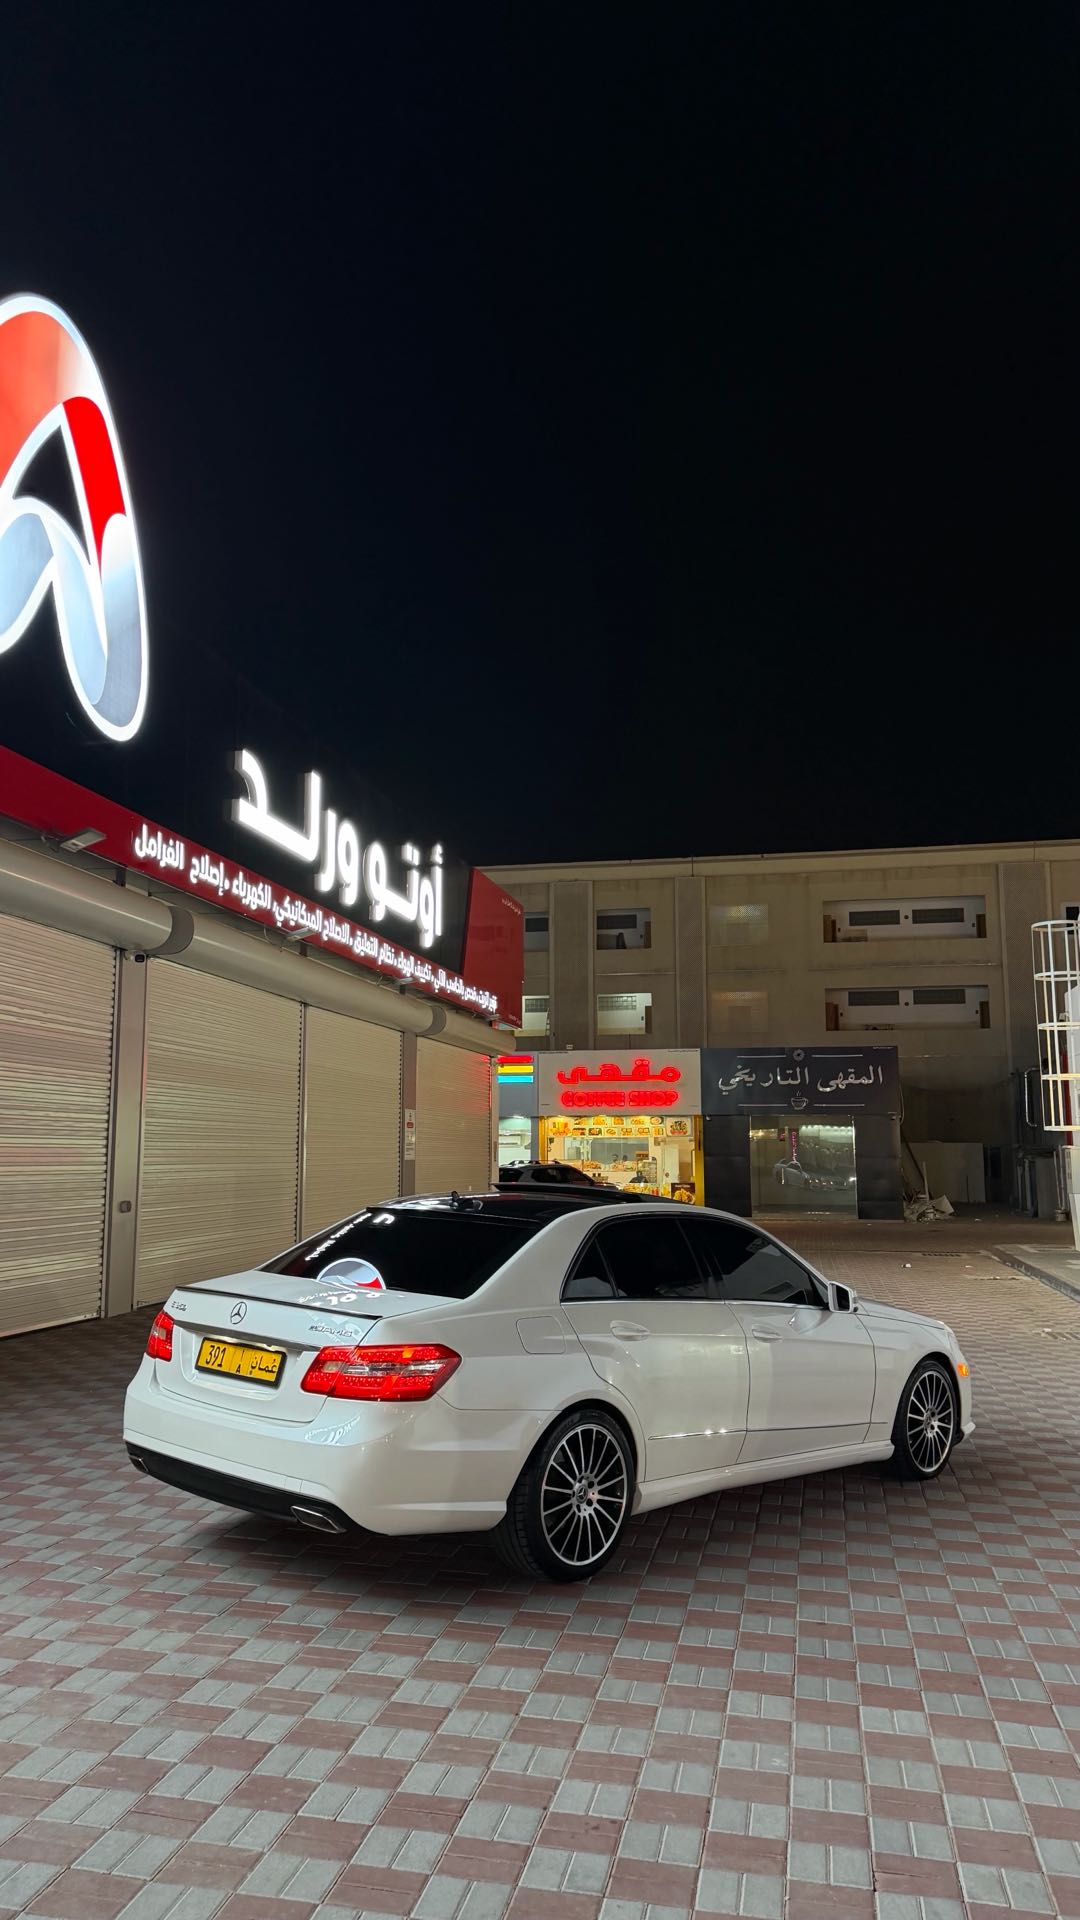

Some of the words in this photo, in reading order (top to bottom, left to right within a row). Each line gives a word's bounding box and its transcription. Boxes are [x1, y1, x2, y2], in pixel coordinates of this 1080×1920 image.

[231, 748, 360, 907] ورلد
[134, 823, 185, 870] الفرامل
[363, 841, 443, 949] أوتو
[557, 1059, 681, 1085] مقهى
[817, 1065, 883, 1093] المقهى
[561, 1091, 625, 1107] COFFEE
[629, 1091, 679, 1107] SHOP
[205, 1345, 226, 1367] 391
[235, 1364, 242, 1374] A
